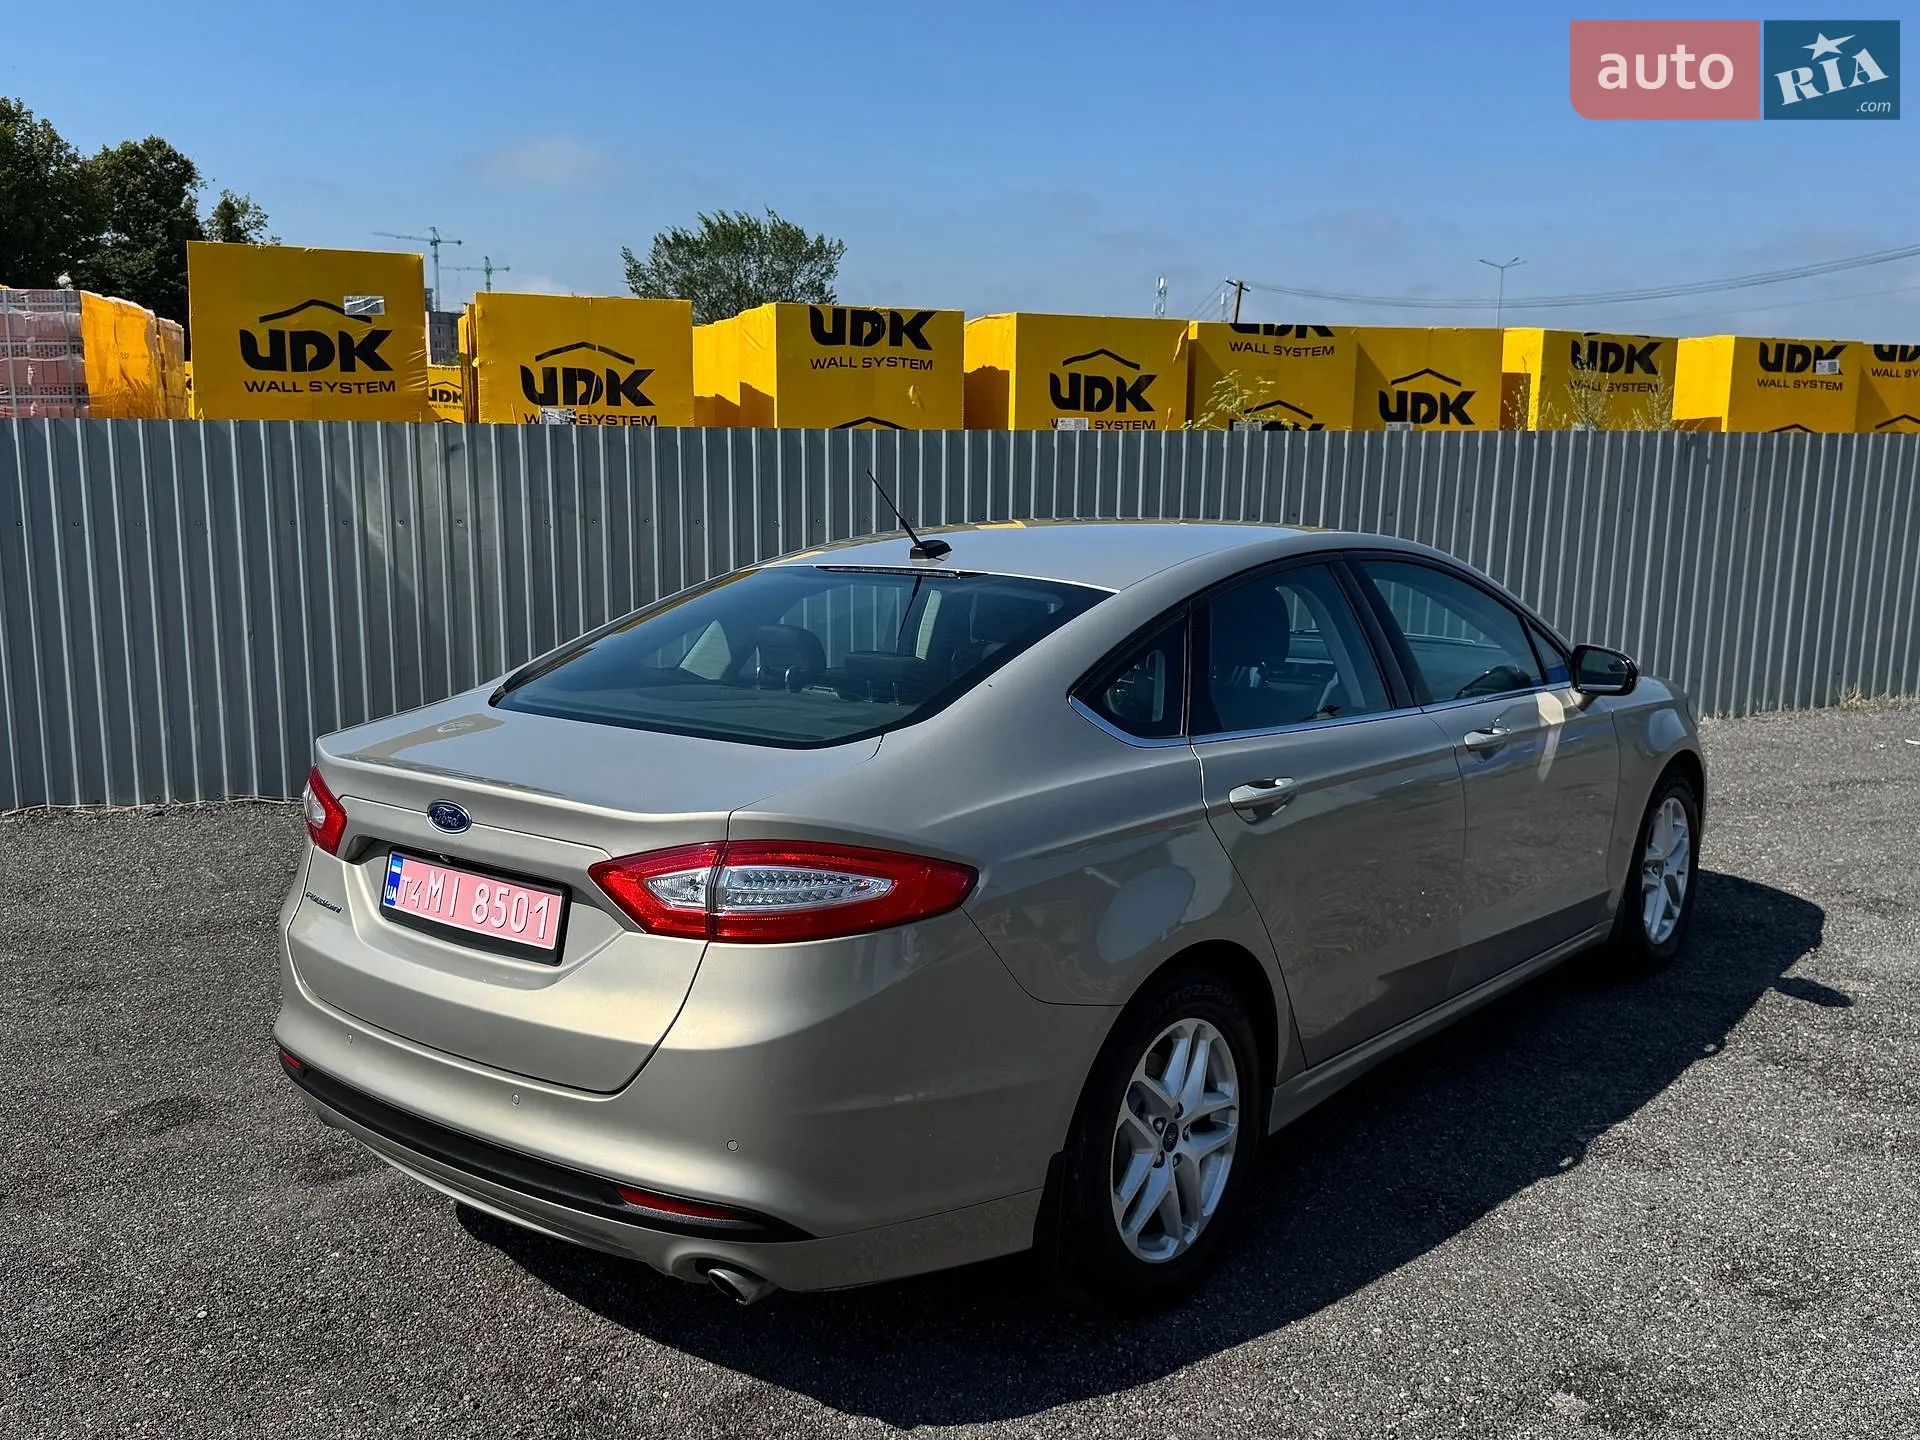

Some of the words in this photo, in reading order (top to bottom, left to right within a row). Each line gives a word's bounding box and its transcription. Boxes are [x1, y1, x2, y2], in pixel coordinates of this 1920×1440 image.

[809, 304, 937, 350] UDK
[239, 329, 395, 372] UDK
[1229, 341, 1270, 354] WALL
[1273, 344, 1335, 357] SYSTEM
[1571, 339, 1662, 375] UDK
[810, 356, 858, 370] WALL
[861, 356, 933, 370] SYSTEM
[1759, 341, 1849, 375] UDK
[1871, 367, 1902, 378] WALL
[244, 381, 304, 393] WALL
[308, 380, 397, 394] SYSTEM
[520, 364, 657, 406] UDK
[1049, 372, 1158, 413] UDK
[1607, 382, 1660, 393] SYSTEM
[1757, 378, 1790, 389] WALL
[1793, 380, 1843, 391] SYSTEM
[1378, 390, 1477, 425] UDK
[579, 413, 658, 425] SYSTEM
[1095, 419, 1156, 430] SYSTEM
[386, 884, 398, 901] UA
[472, 883, 550, 940] 8501
